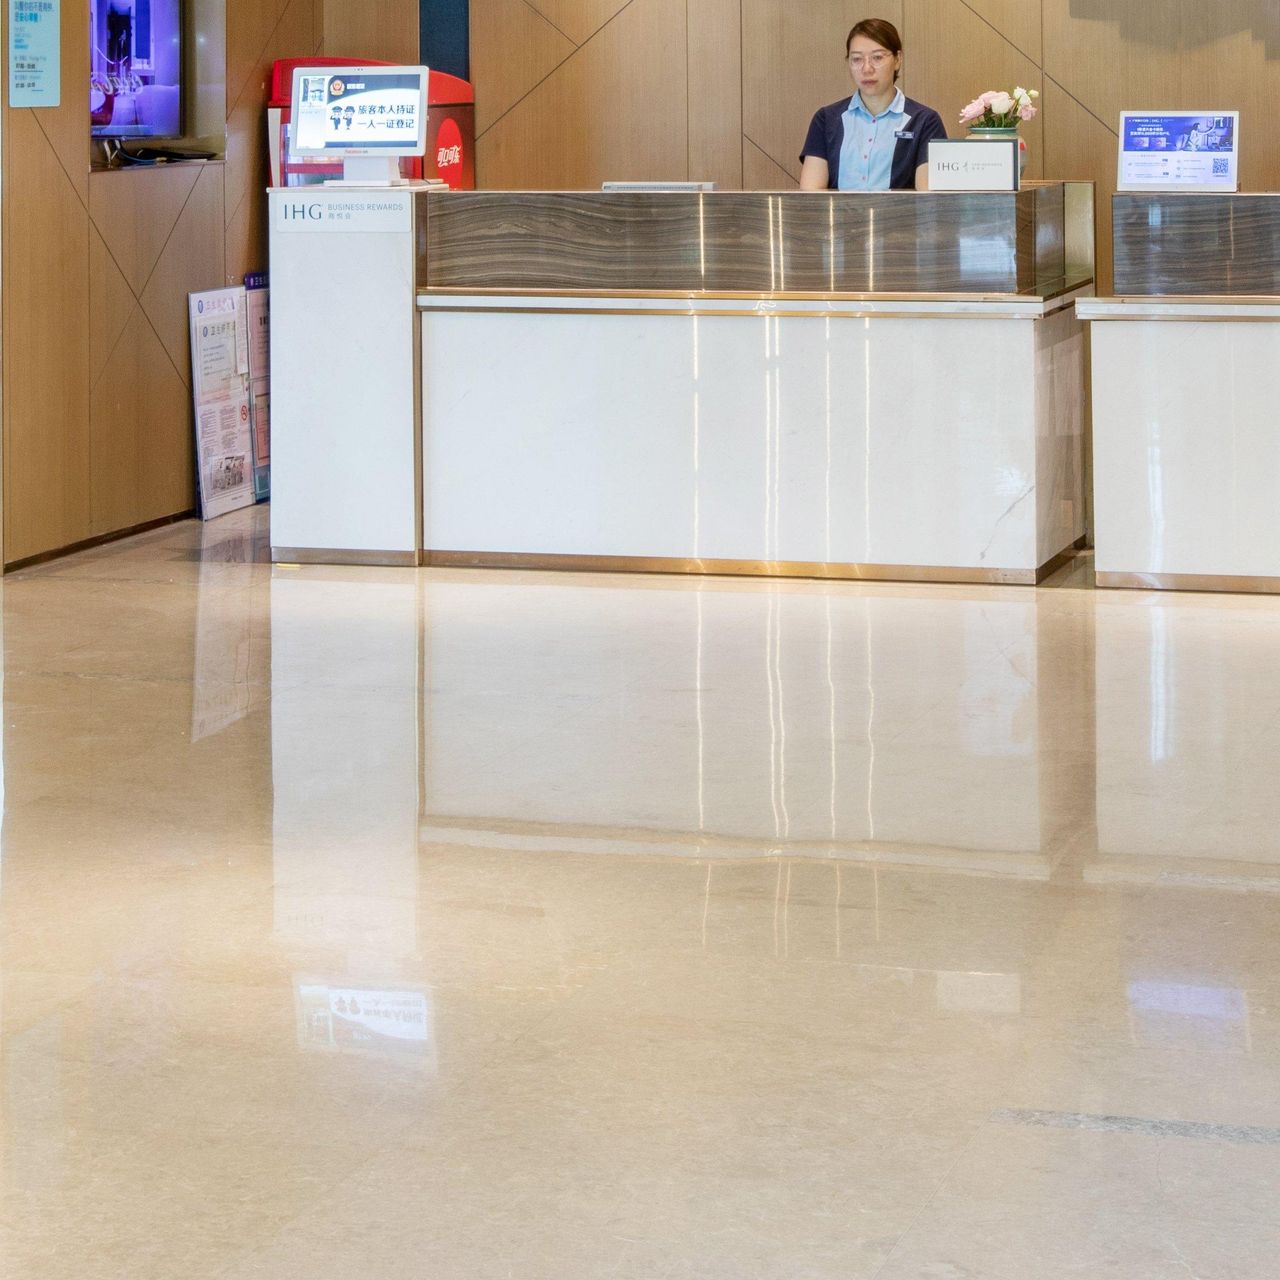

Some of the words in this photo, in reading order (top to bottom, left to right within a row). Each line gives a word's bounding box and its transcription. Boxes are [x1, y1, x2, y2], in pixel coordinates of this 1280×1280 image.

[358, 104, 415, 114] 旅客本人持证
[357, 119, 414, 129] 一人一证登记
[937, 162, 959, 171] IHG
[284, 203, 322, 220] IHG
[327, 203, 365, 211] BUSINESS
[366, 203, 404, 211] REWARDS
